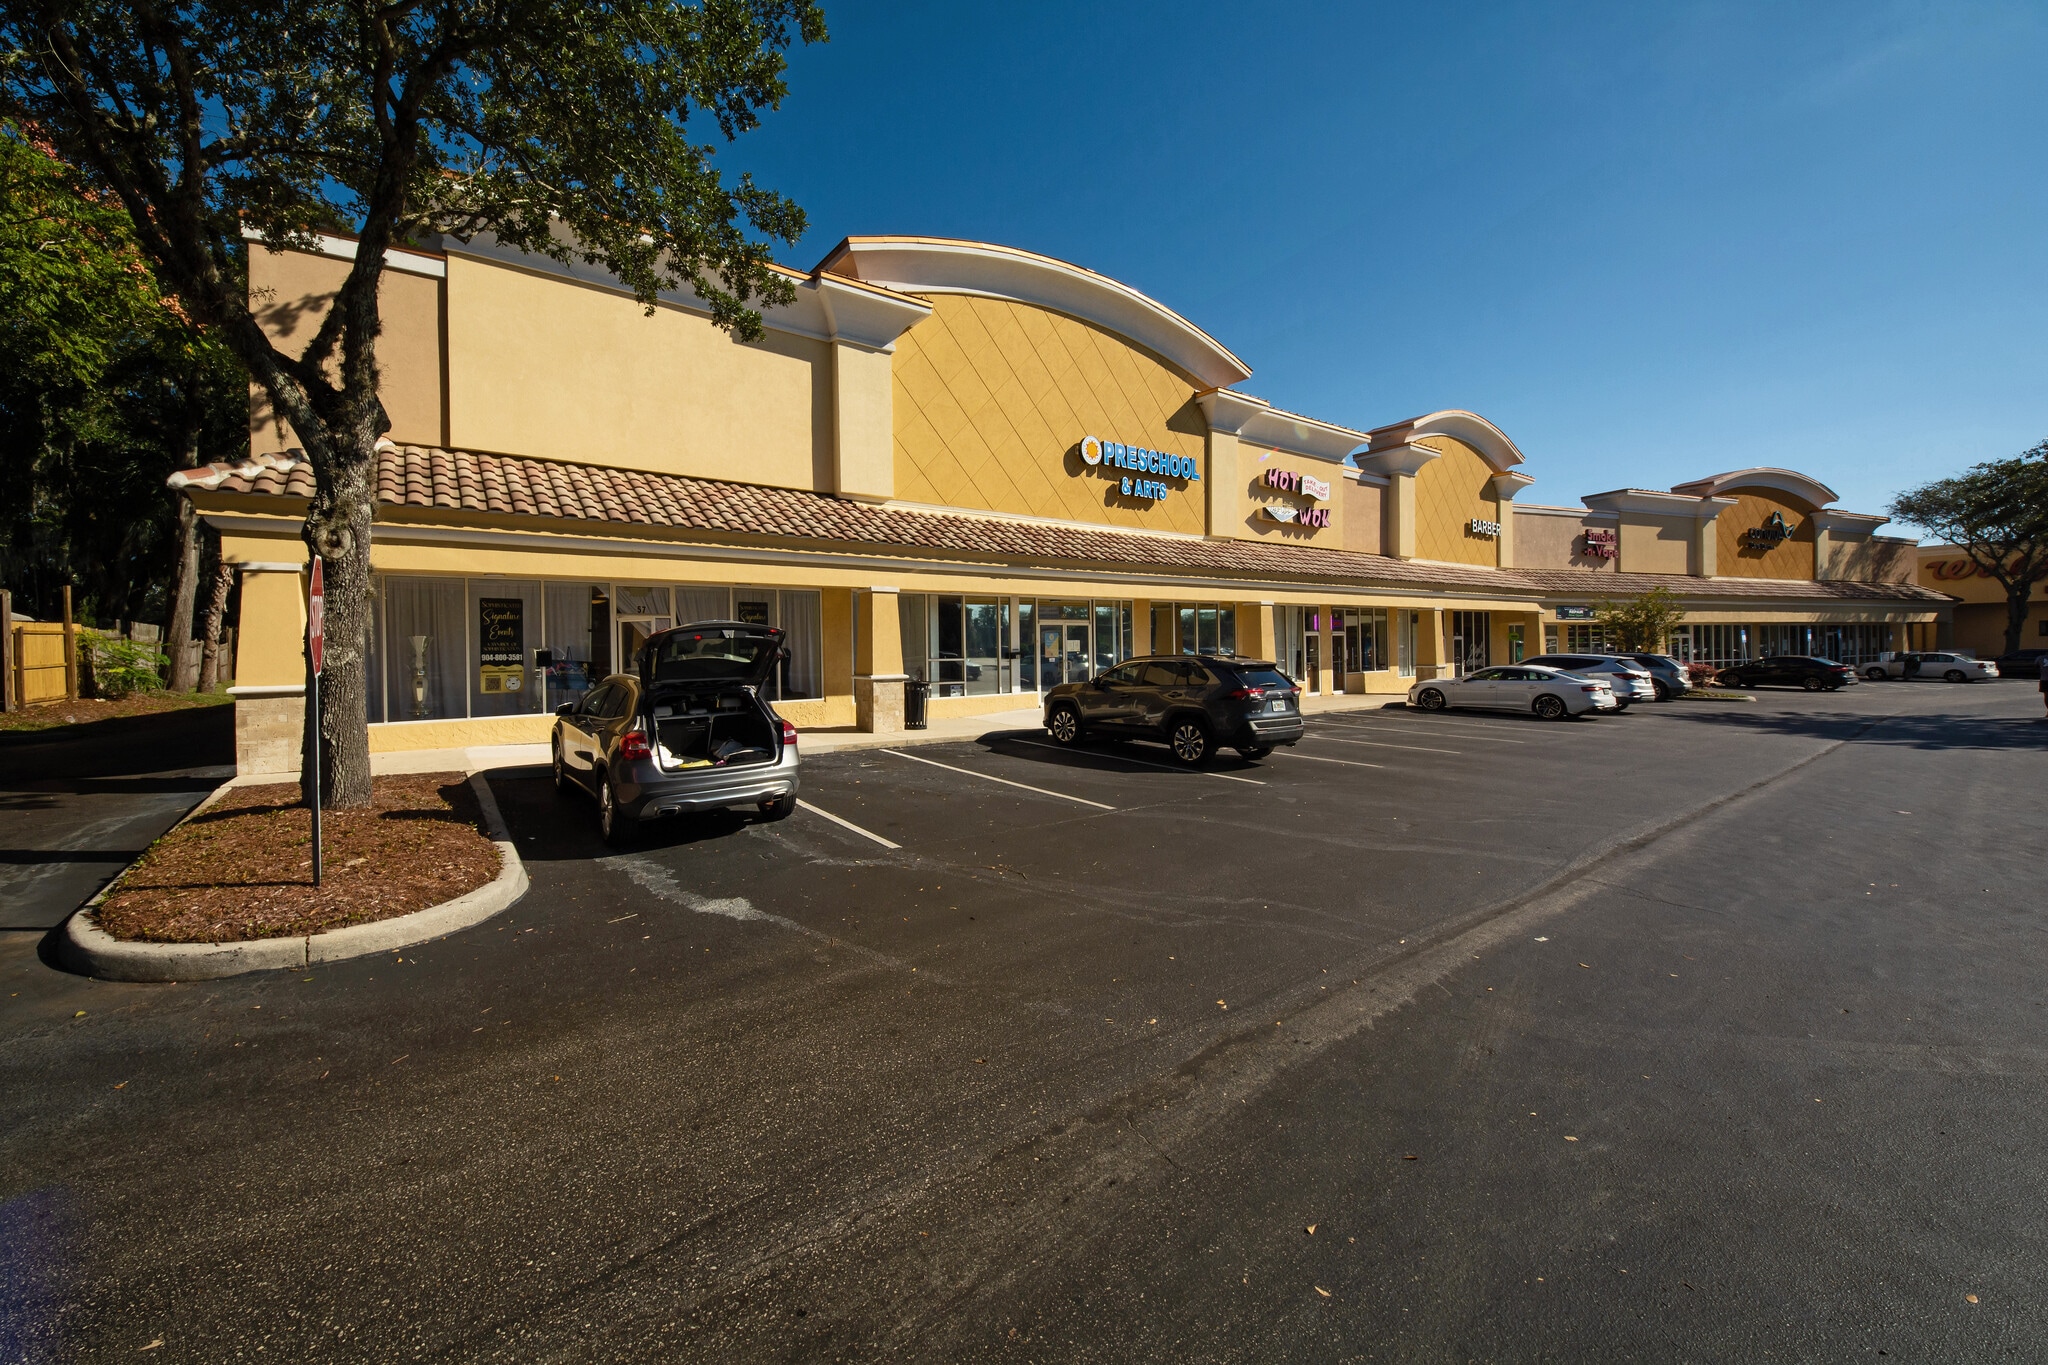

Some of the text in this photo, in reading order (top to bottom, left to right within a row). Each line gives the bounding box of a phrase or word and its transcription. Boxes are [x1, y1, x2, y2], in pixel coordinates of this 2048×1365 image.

[1103, 440, 1200, 481] PRESCHOOL
[1121, 476, 1167, 501] & ARTS
[1268, 468, 1298, 491] HOT
[1305, 485, 1327, 498] DELIVERY
[1300, 508, 1331, 528] WOK
[1472, 518, 1501, 537] BARBER
[1587, 529, 1617, 542] Smoke
[311, 594, 323, 639] STOP
[482, 609, 520, 625] Signature
[489, 624, 514, 640] Events
